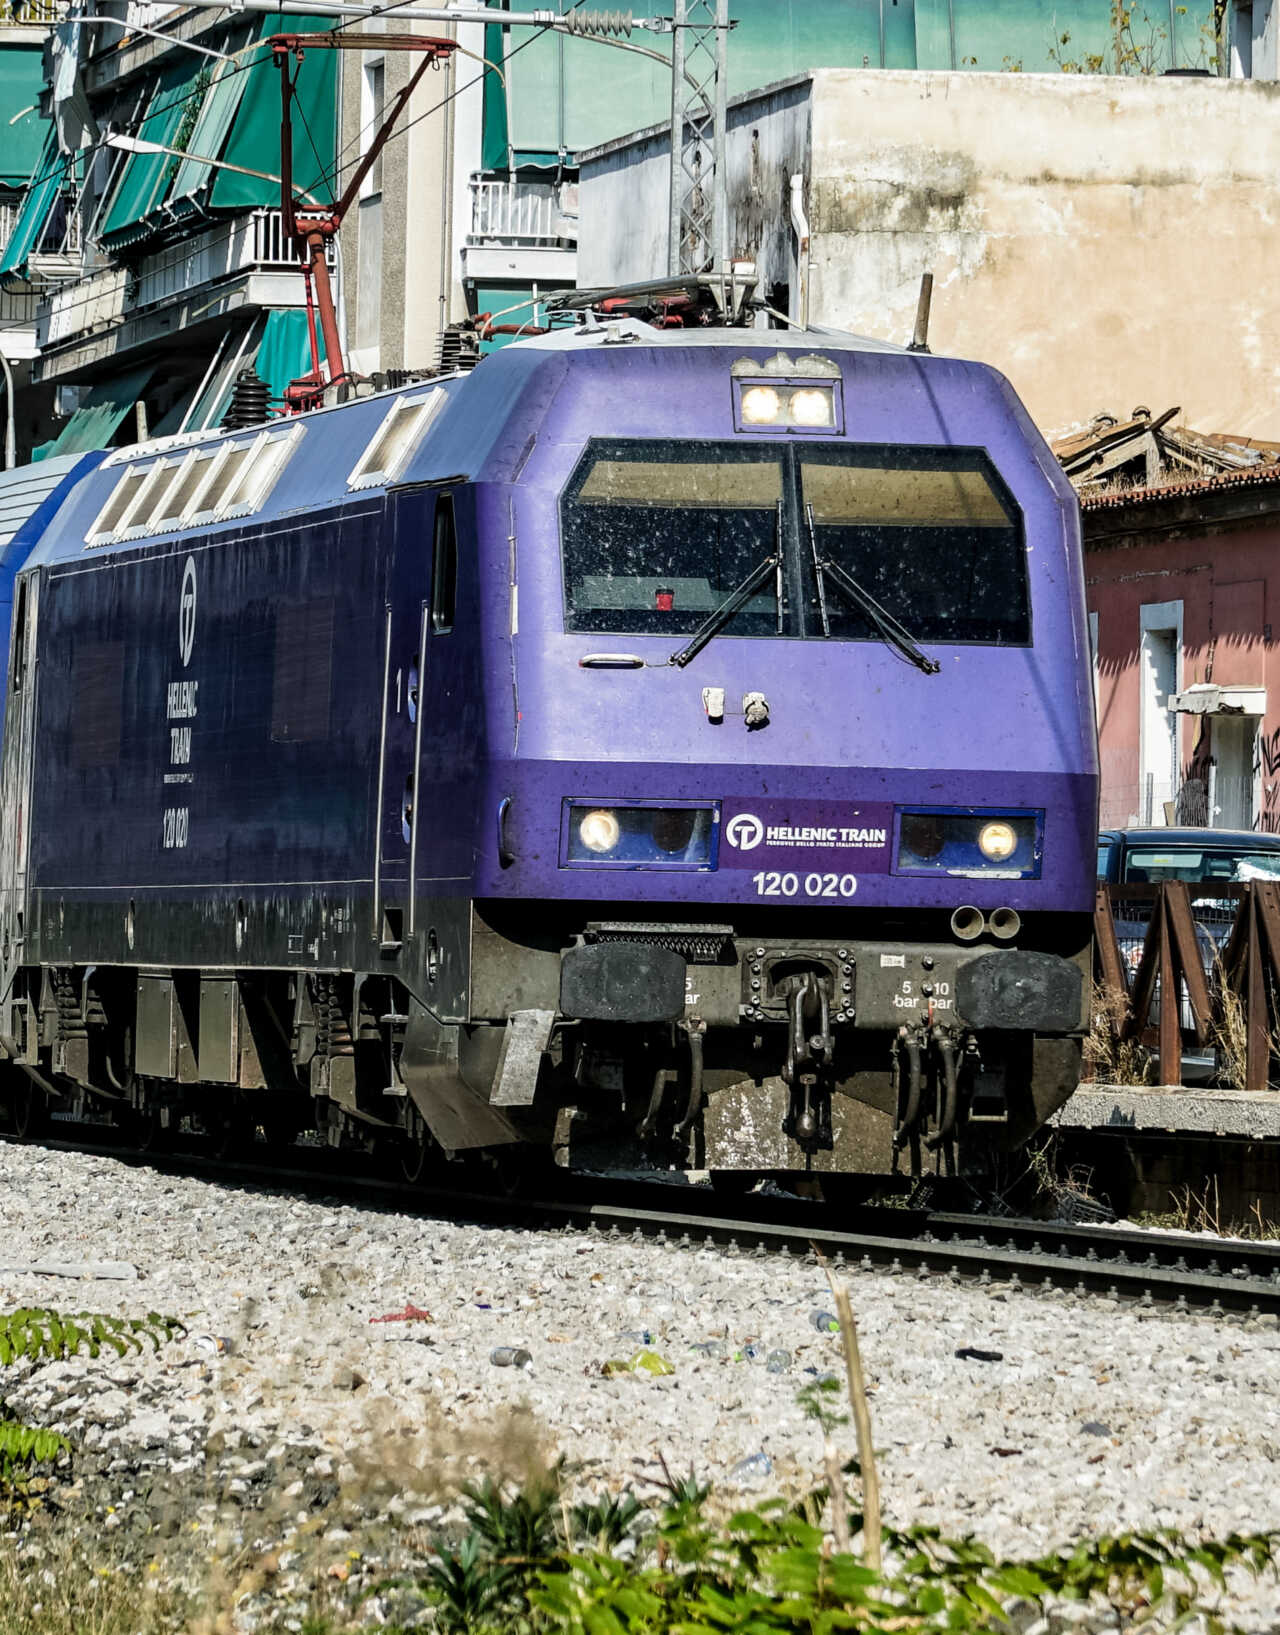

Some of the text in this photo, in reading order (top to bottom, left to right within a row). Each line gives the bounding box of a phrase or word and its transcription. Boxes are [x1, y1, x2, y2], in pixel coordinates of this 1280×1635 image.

[166, 680, 199, 719] HELLENIC
[170, 727, 192, 765] TRAIN
[766, 826, 886, 842] HELLENIC TRAIN
[752, 872, 857, 897] 120 020
[902, 980, 912, 994] 5
[934, 982, 949, 995] 10
[685, 993, 700, 1004] ar
[894, 994, 919, 1008] bar
[928, 996, 953, 1009] bar
